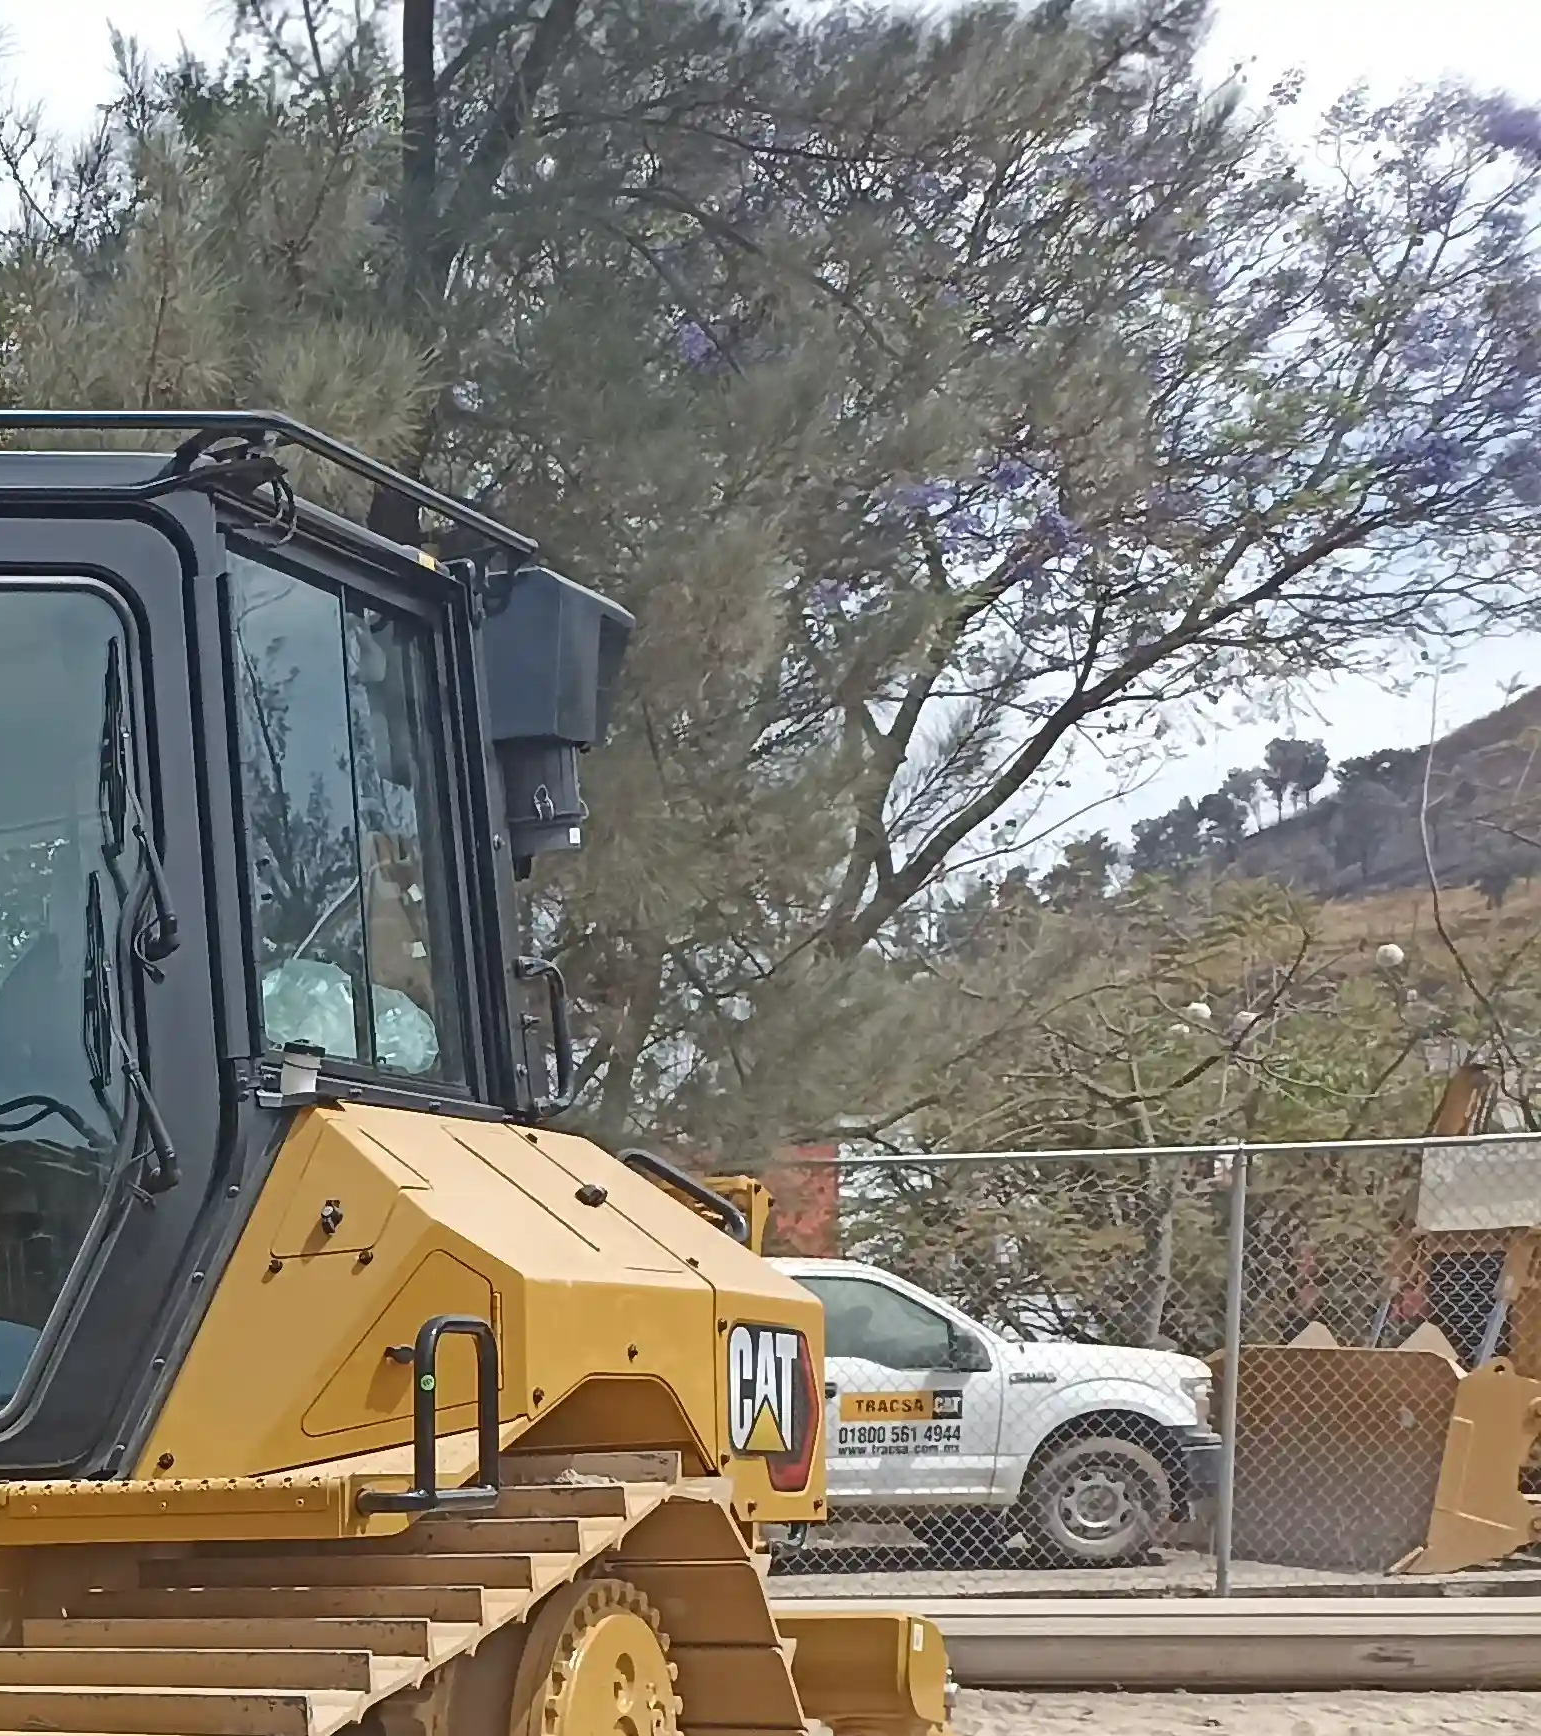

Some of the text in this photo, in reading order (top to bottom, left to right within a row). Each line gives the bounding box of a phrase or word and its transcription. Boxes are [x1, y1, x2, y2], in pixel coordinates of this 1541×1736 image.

[729, 1326, 798, 1451] CAT
[855, 1397, 924, 1413] TRACSA
[838, 1424, 961, 1444] 01800 561 4944
